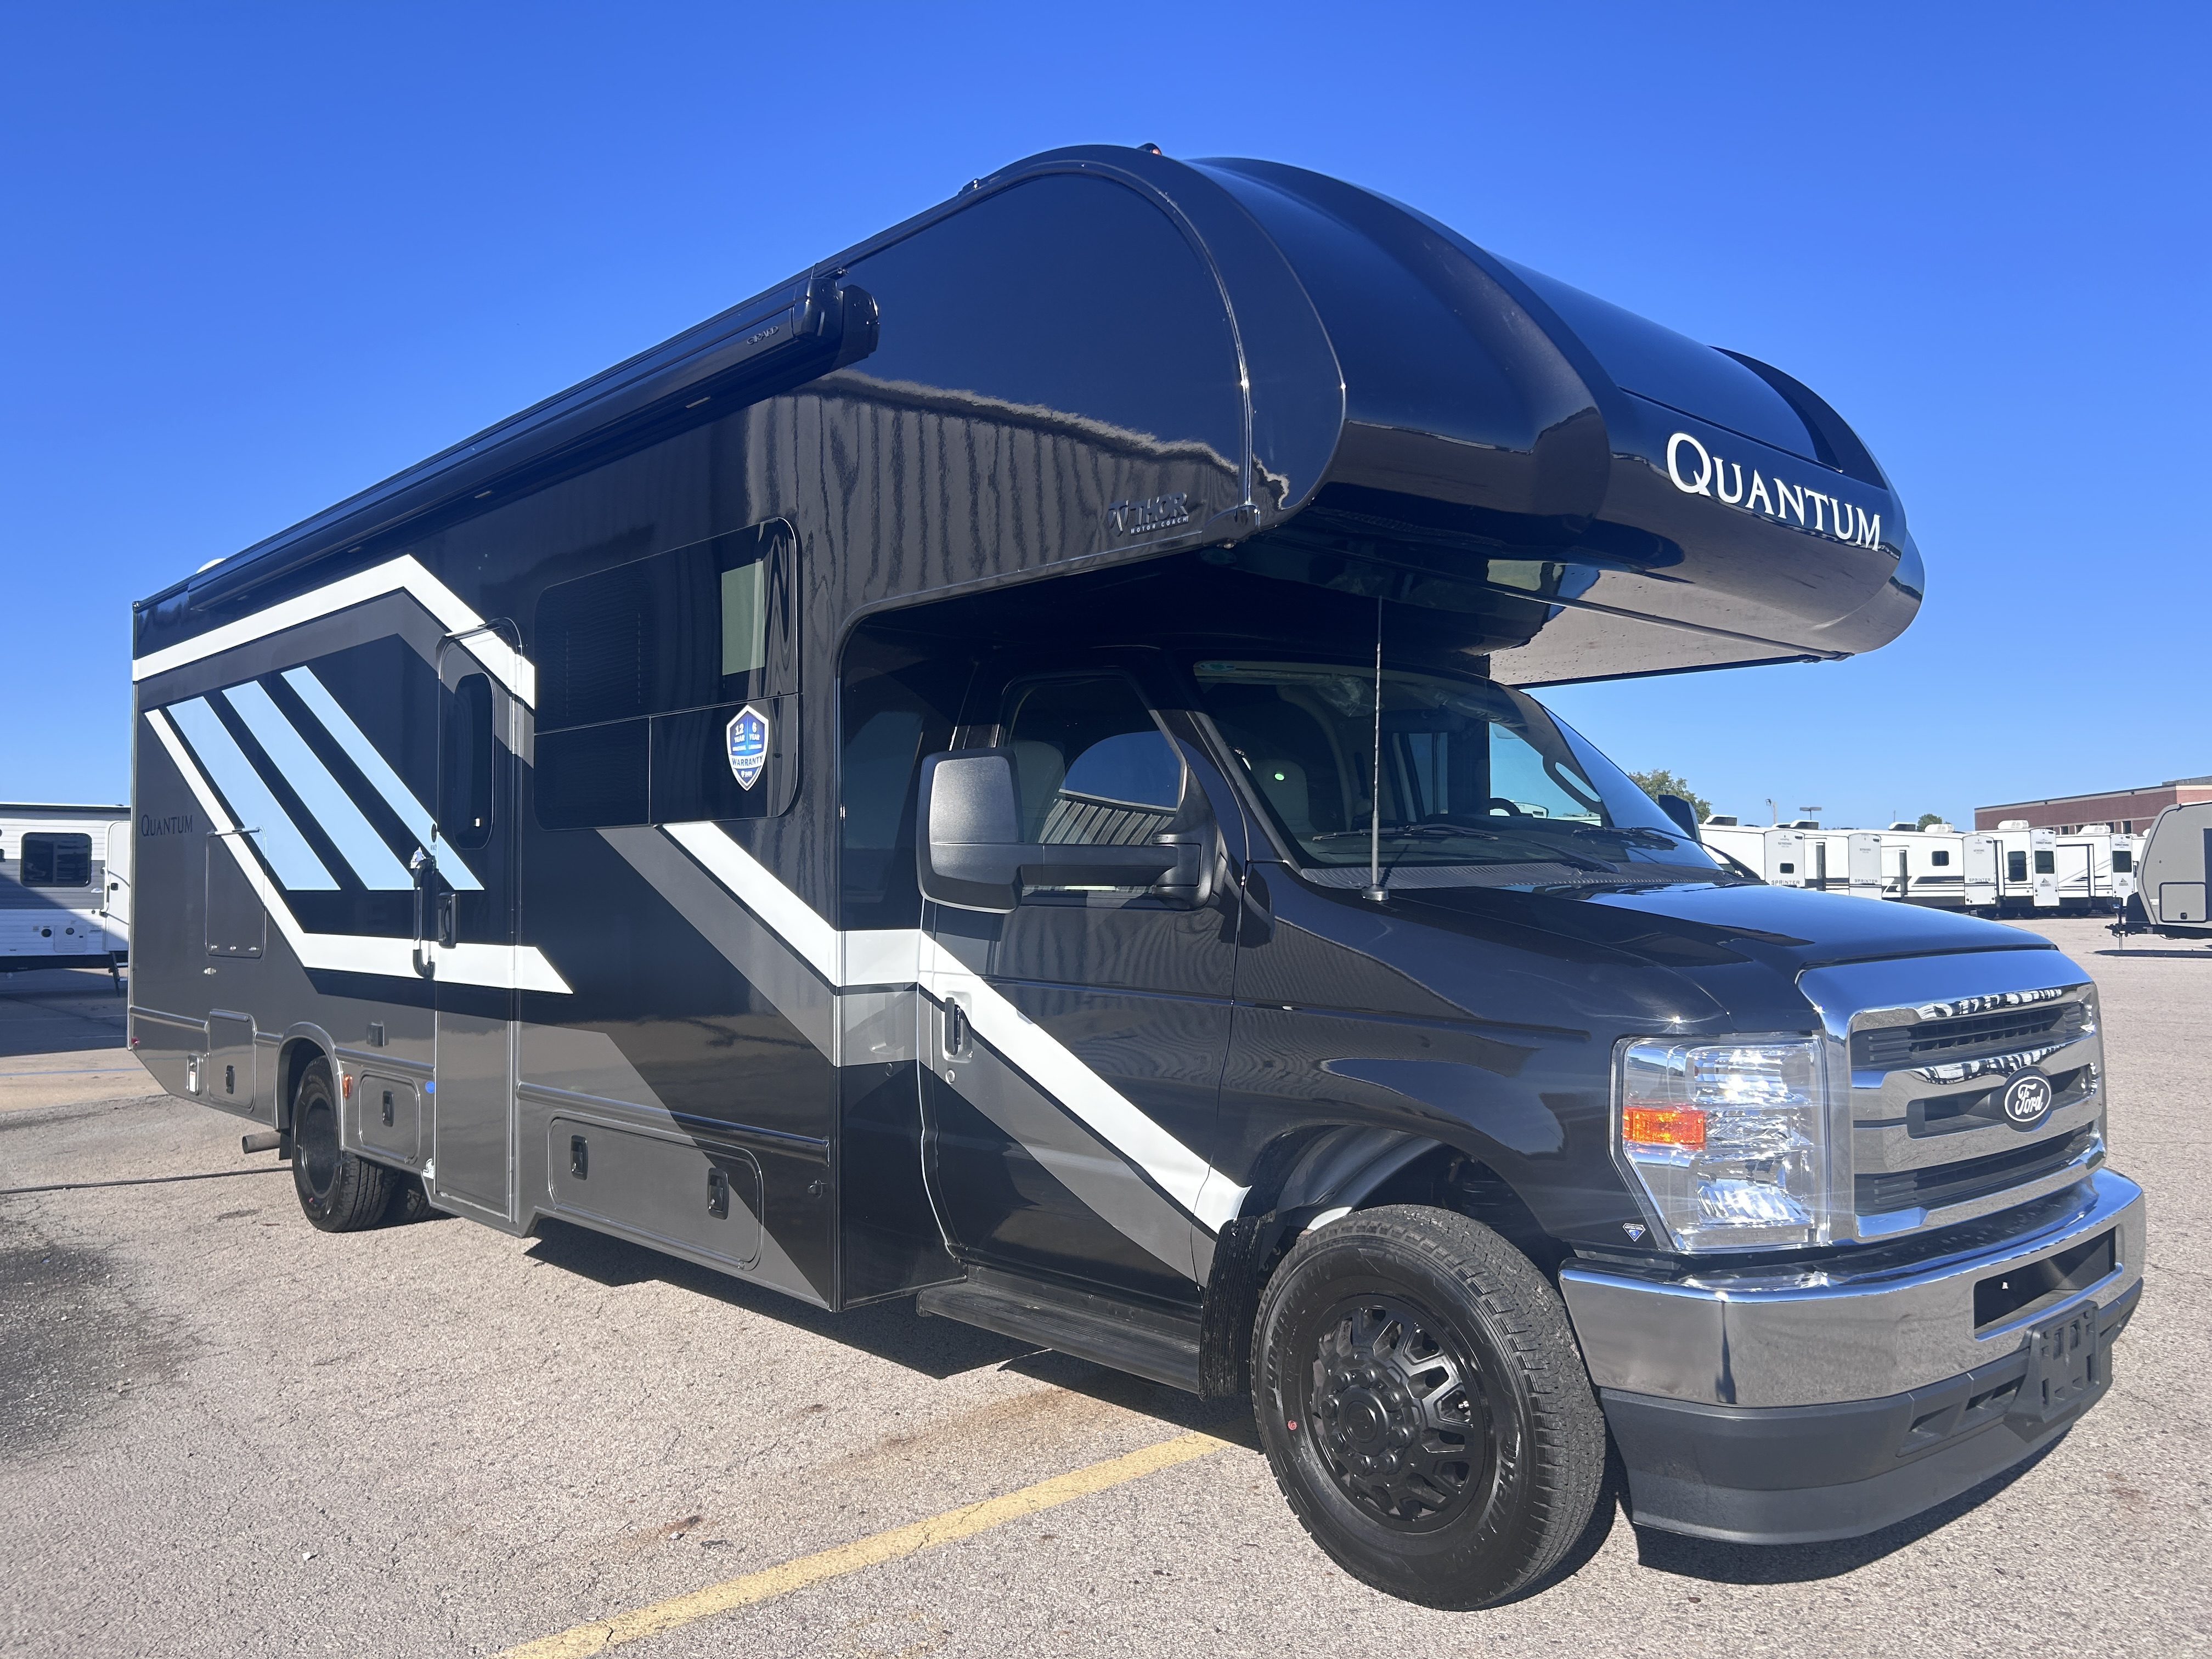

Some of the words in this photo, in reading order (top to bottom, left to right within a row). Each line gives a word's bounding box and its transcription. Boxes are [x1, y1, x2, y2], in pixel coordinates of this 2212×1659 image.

[1667, 432, 1880, 552] QUANTUM
[1130, 493, 1188, 526] THOR
[1130, 524, 1156, 534] MOTOR
[1161, 516, 1189, 528] COACH
[735, 723, 744, 736] 12
[752, 722, 757, 733] 6
[734, 734, 745, 743] YEAR
[732, 755, 763, 766] WARRANTY
[141, 814, 193, 837] QUANTUM
[2015, 1083, 2044, 1115] Ford
